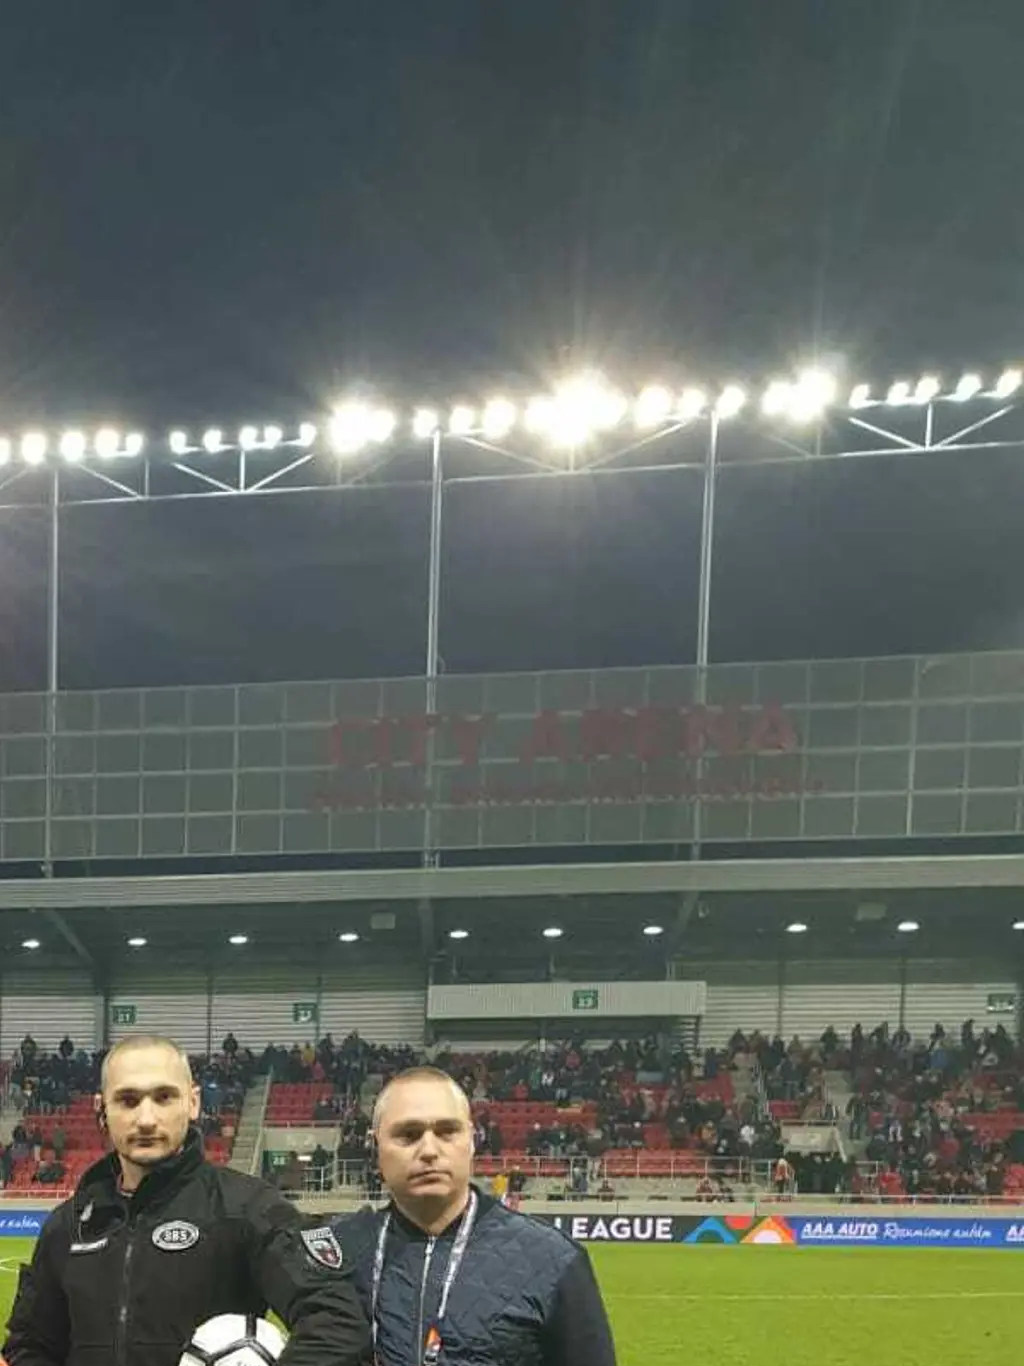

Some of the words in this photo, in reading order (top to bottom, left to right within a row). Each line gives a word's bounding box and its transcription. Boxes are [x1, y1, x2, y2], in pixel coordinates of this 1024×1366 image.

[326, 713, 490, 768] CITY
[520, 700, 797, 764] ARENA
[802, 1223, 834, 1237] AAA
[838, 1223, 879, 1238] AUTO
